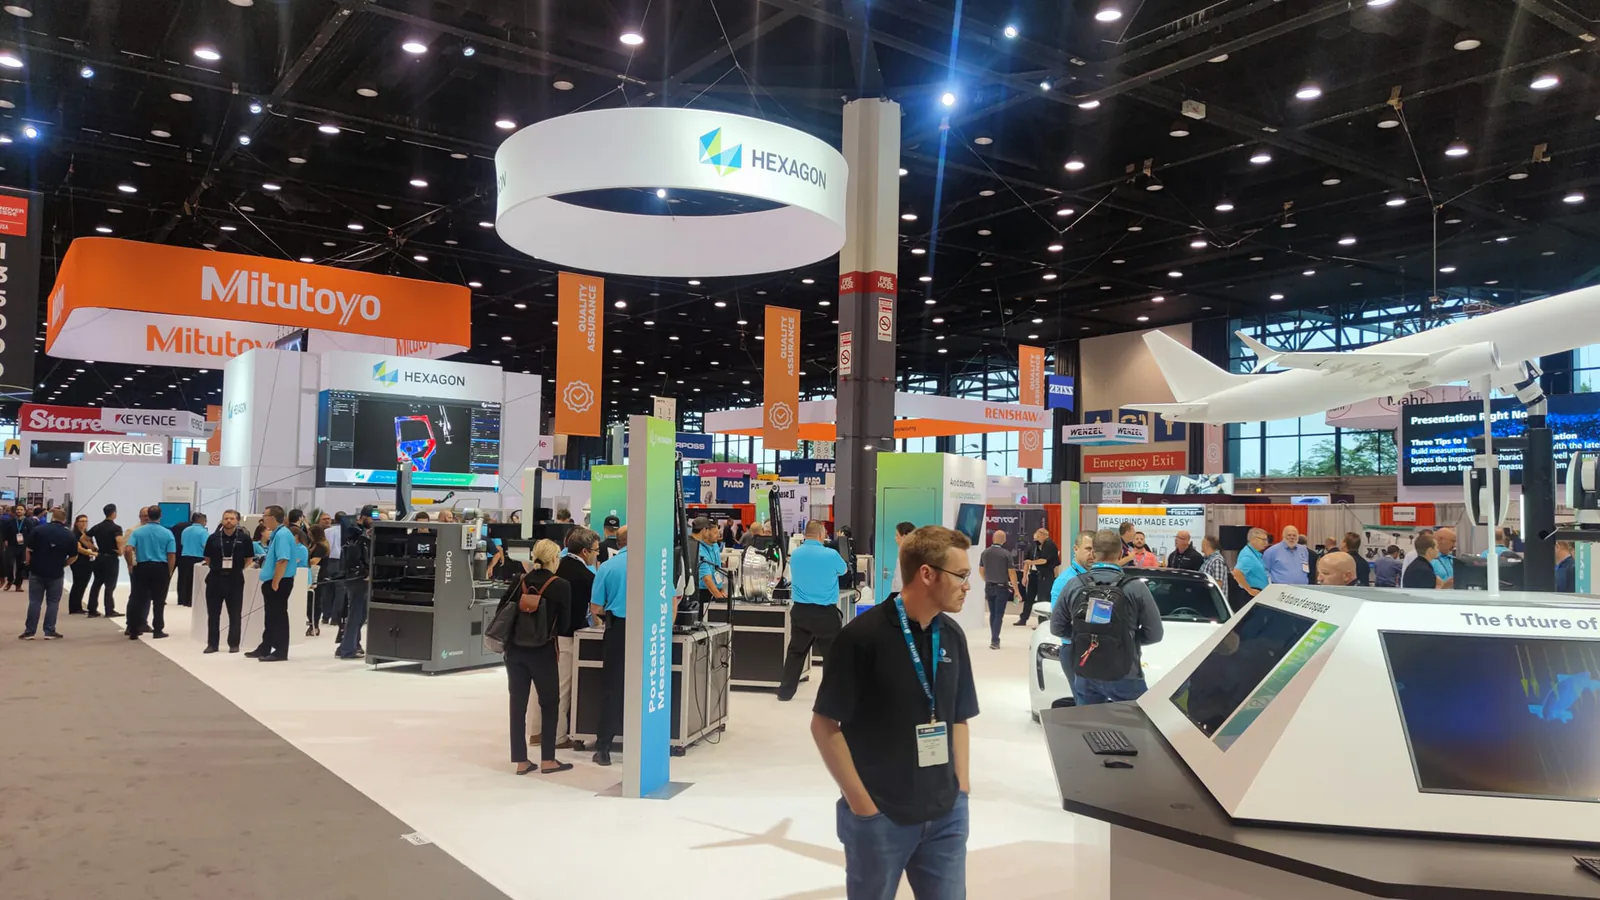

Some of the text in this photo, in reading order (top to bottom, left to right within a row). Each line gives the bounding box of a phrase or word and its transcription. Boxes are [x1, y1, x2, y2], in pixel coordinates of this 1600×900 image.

[752, 149, 826, 190] HEXAGON
[840, 281, 854, 290] HOSE
[877, 281, 894, 290] HOSE
[202, 266, 380, 325] Mitutoyo
[579, 284, 587, 332] QUALITY
[588, 285, 596, 352] ASSURANCE
[404, 371, 465, 386] HEXAGON
[1049, 384, 1073, 396] ZEISS
[29, 409, 102, 432] Starre
[115, 413, 176, 426] KEYENCE
[984, 407, 1038, 422] RENISHAW
[1411, 410, 1528, 425] Presentation Rght No
[1070, 427, 1104, 436] WENZEL
[1117, 427, 1143, 436] WENZEL
[89, 441, 162, 456] KEYENCE
[676, 442, 705, 450] RPOSS
[1411, 438, 1433, 446] Three
[1434, 437, 1452, 447] Tips
[1411, 447, 1429, 455] Build
[1568, 442, 1583, 450] the
[1093, 454, 1175, 470] Emergency Exit
[1411, 456, 1434, 465] bypass
[1411, 465, 1448, 474] processing
[723, 480, 744, 489] FARO
[1168, 507, 1203, 515] fischer
[1099, 517, 1142, 527] MEASURING
[1144, 518, 1167, 526] MADE
[445, 550, 453, 585] TEMPO
[1460, 612, 1598, 631] The future of
[658, 548, 668, 710] Measuring Arms
[648, 623, 658, 713] Portable
